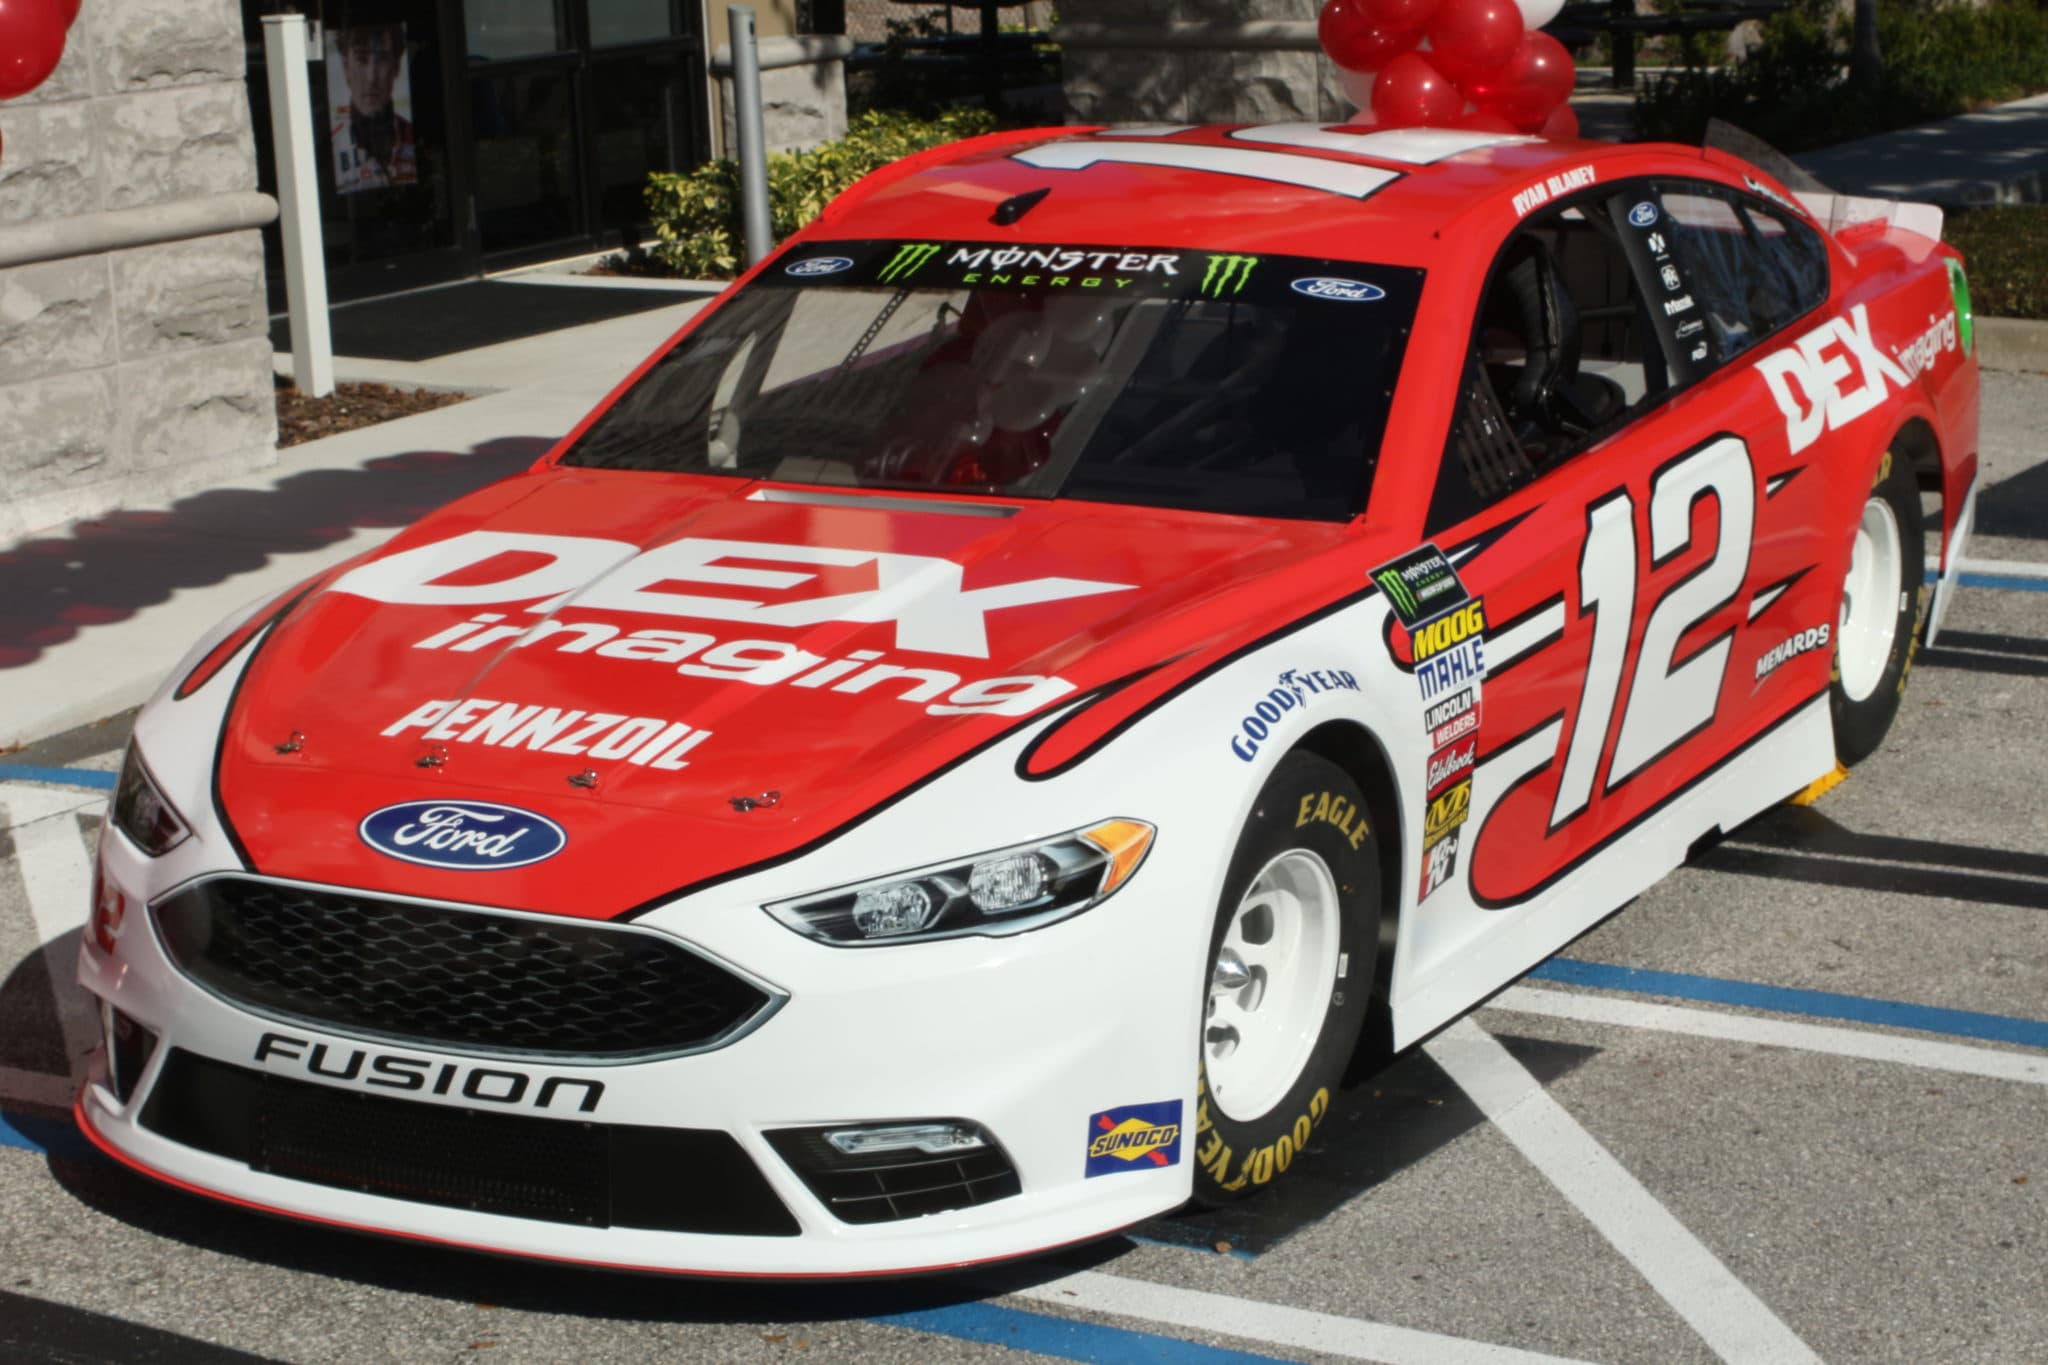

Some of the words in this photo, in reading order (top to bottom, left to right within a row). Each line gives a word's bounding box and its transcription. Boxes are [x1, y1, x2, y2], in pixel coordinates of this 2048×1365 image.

[1512, 182, 1548, 217] RYAN
[1546, 165, 1596, 197] BLANEY
[962, 273, 1133, 288] ENERGY
[1306, 279, 1368, 298] Ford
[1753, 303, 1912, 457] DEX
[1890, 311, 1956, 380] imaging
[327, 530, 1142, 659] DEX
[1414, 600, 1484, 661] MOOG
[1547, 433, 1757, 837] 12
[1755, 623, 1830, 679] MENARDS
[413, 612, 1079, 717] imaging
[1416, 639, 1485, 701] MAHLE
[381, 699, 713, 771] PENNZOIL
[1426, 690, 1472, 731] LINCOLN
[1436, 711, 1477, 745] WELDERS
[1428, 741, 1475, 791] Edelbrock
[393, 803, 531, 860] Ford
[1294, 791, 1369, 851] EAGLE
[254, 1032, 606, 1113] FUSION
[1092, 1126, 1176, 1155] SUNOCO
